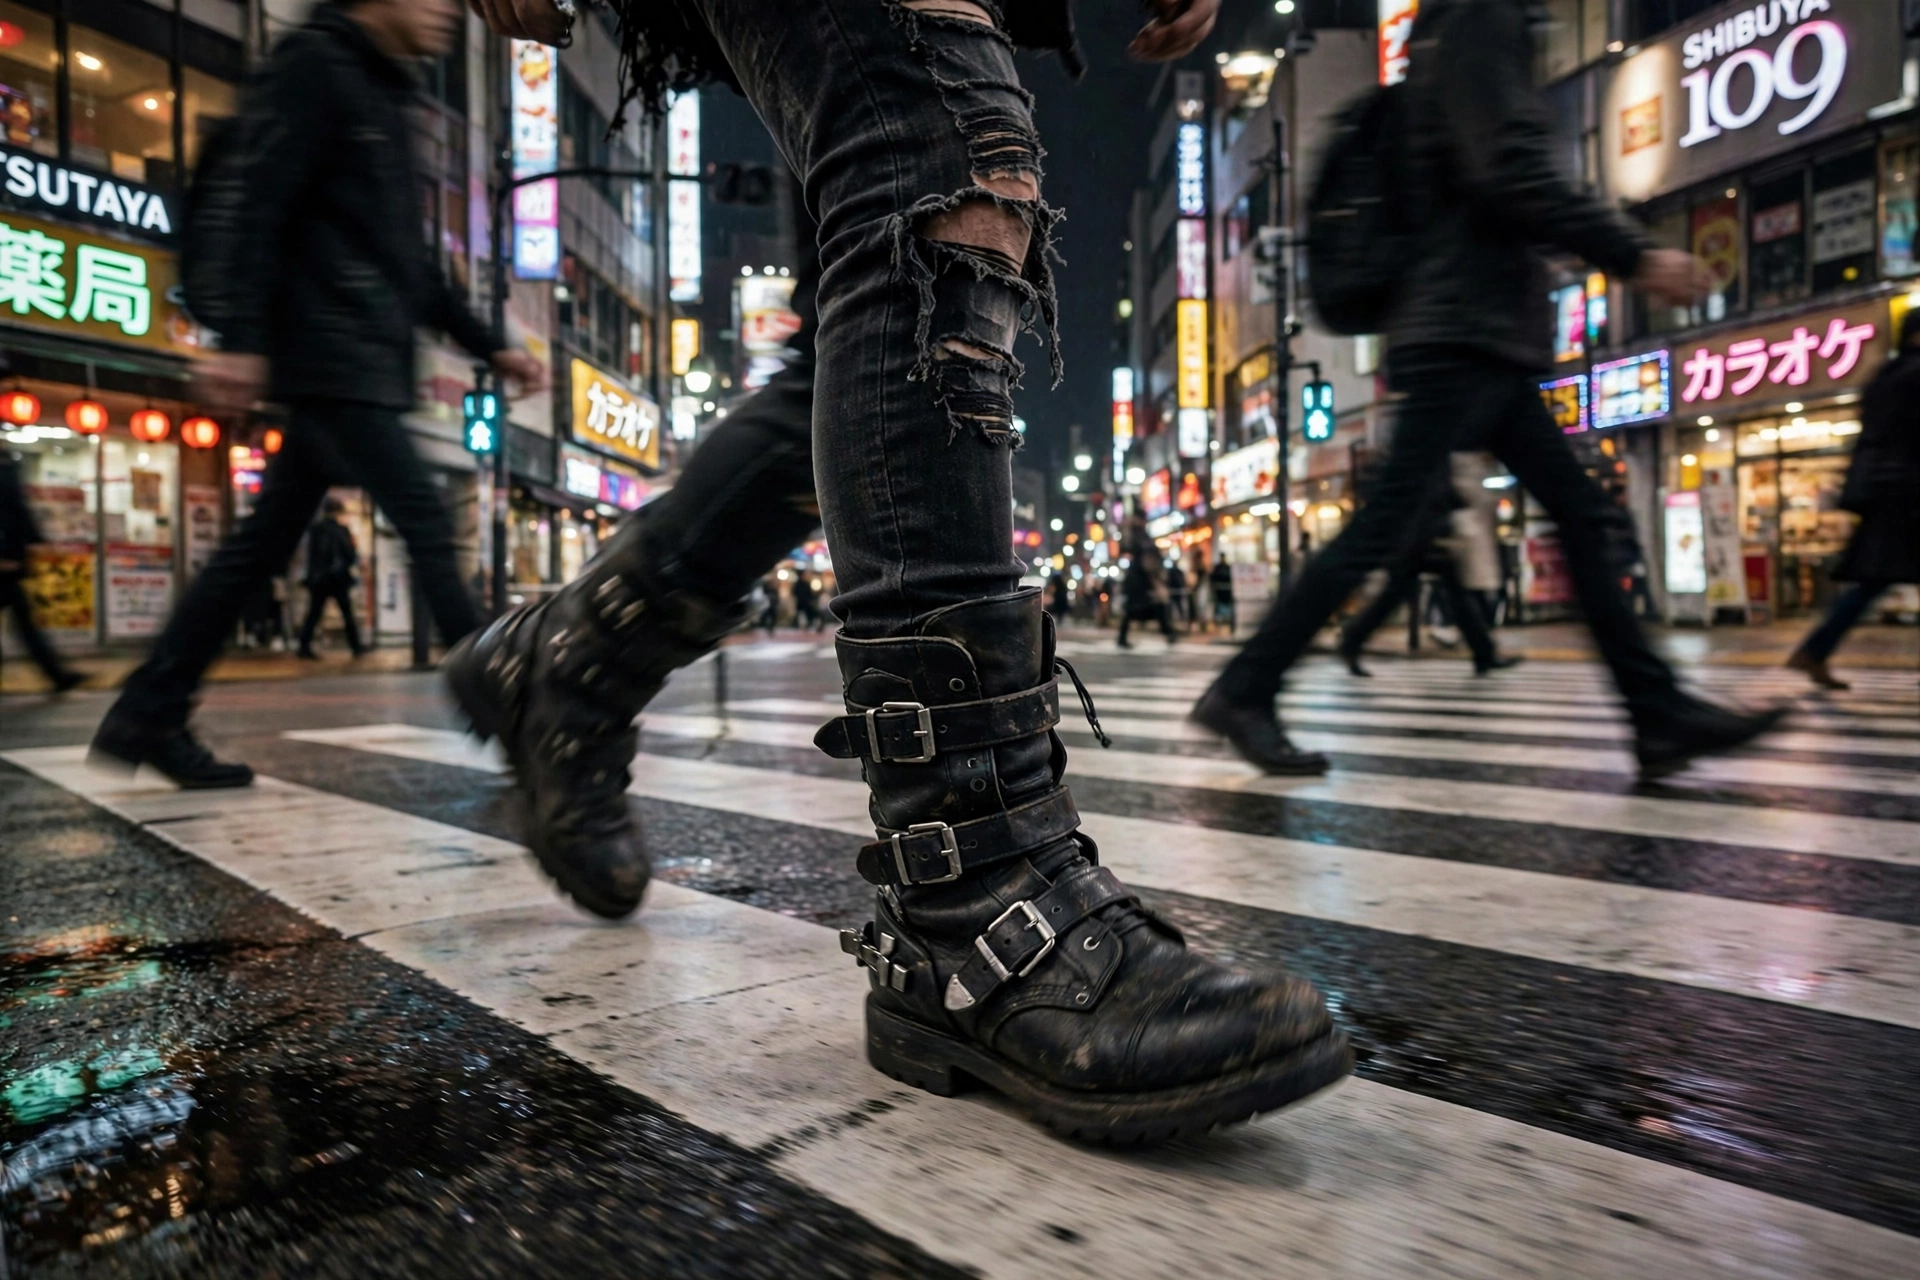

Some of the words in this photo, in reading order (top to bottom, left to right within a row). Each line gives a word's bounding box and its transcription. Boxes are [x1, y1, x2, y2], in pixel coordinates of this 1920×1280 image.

[1679, 20, 1847, 148] 109
[0, 151, 172, 234] SUTAYA
[0, 222, 151, 336] 薬局
[1682, 318, 1875, 402] カラオケ
[586, 380, 655, 451] カラオケ
